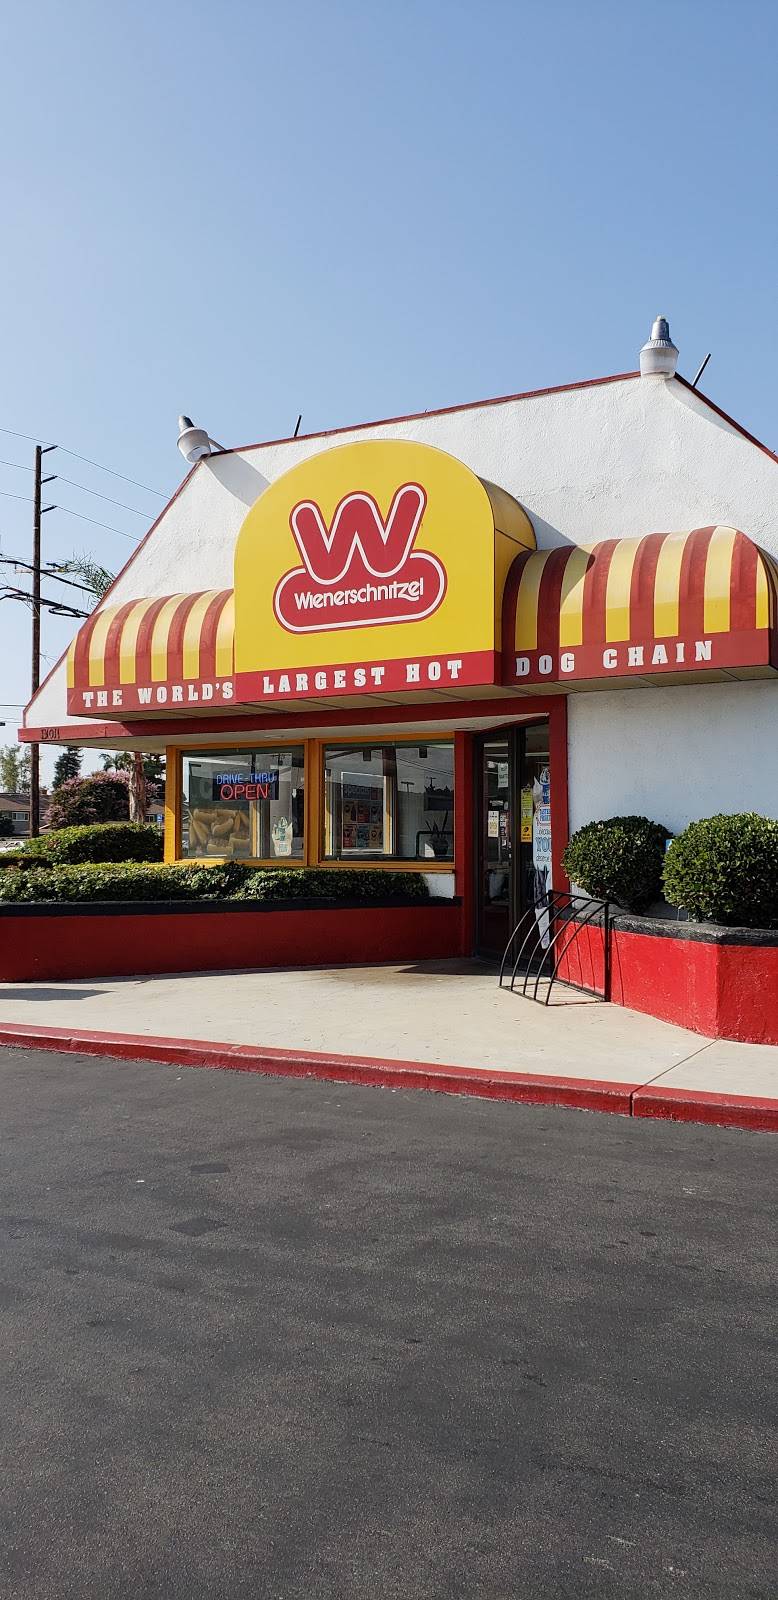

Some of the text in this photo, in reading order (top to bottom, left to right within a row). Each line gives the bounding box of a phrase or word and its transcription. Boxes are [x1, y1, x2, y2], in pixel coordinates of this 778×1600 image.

[290, 482, 427, 585] W
[294, 577, 424, 610] Wienerschnitzel
[515, 640, 713, 677] DOG CHAIN
[262, 660, 462, 694] LARGEST HOT
[83, 682, 234, 708] THE WORLD'S
[220, 783, 269, 800] OPEN
[535, 836, 551, 853] YO
